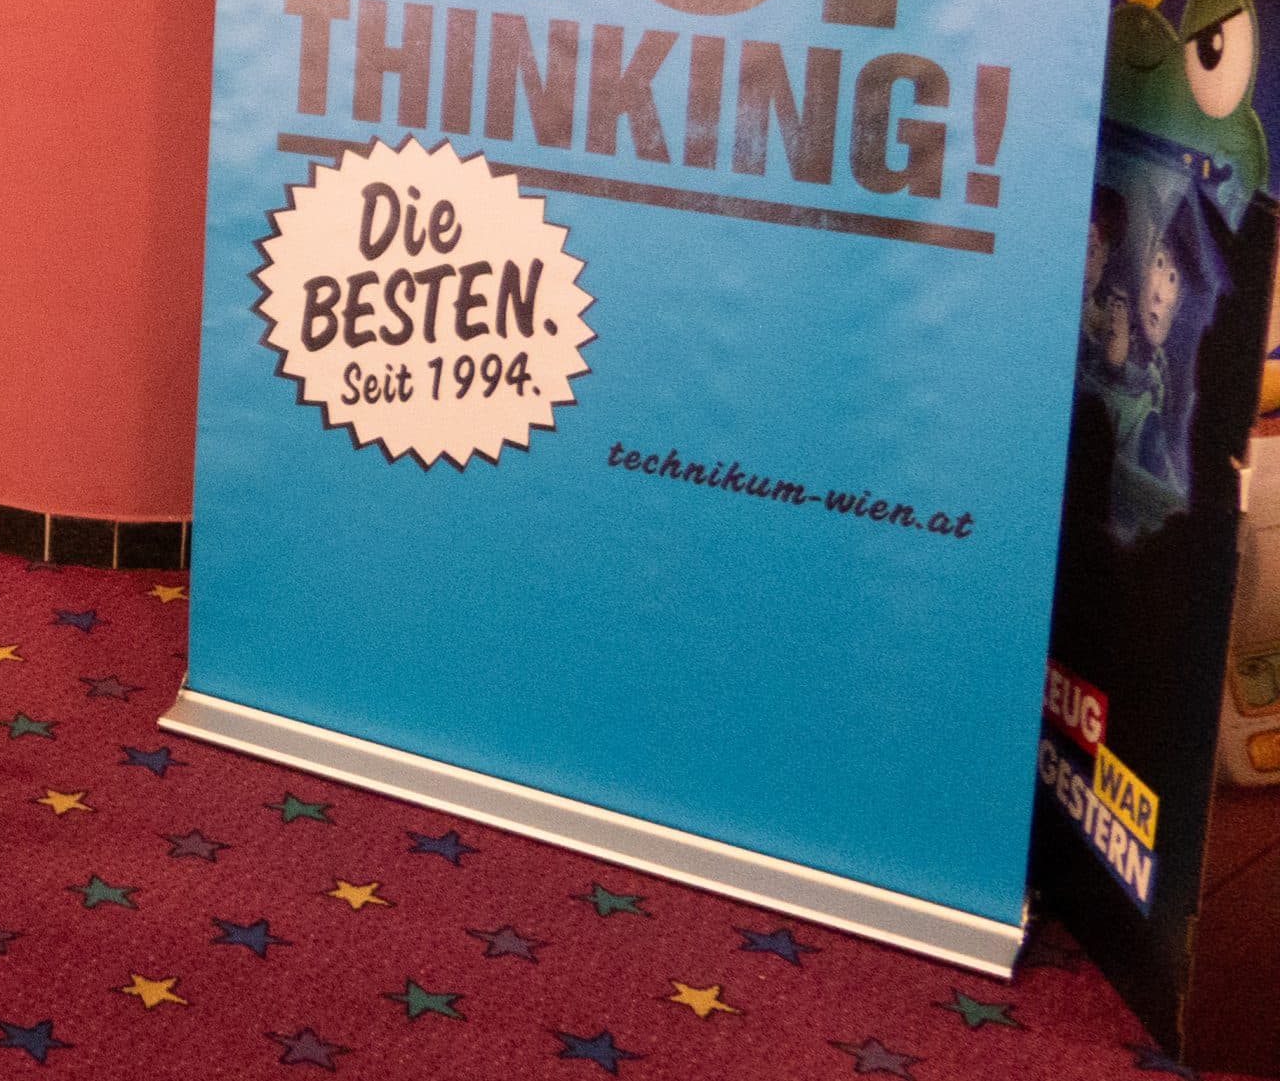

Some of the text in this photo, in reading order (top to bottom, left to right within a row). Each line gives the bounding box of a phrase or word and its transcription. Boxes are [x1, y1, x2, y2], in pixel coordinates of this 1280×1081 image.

[358, 180, 463, 262] Die
[300, 257, 559, 353] BESTEN.
[340, 350, 542, 406] Seit 1994.
[606, 440, 977, 540] technikum-wien.at
[1039, 738, 1153, 904] GESTERN
[1099, 754, 1154, 837] WAR
